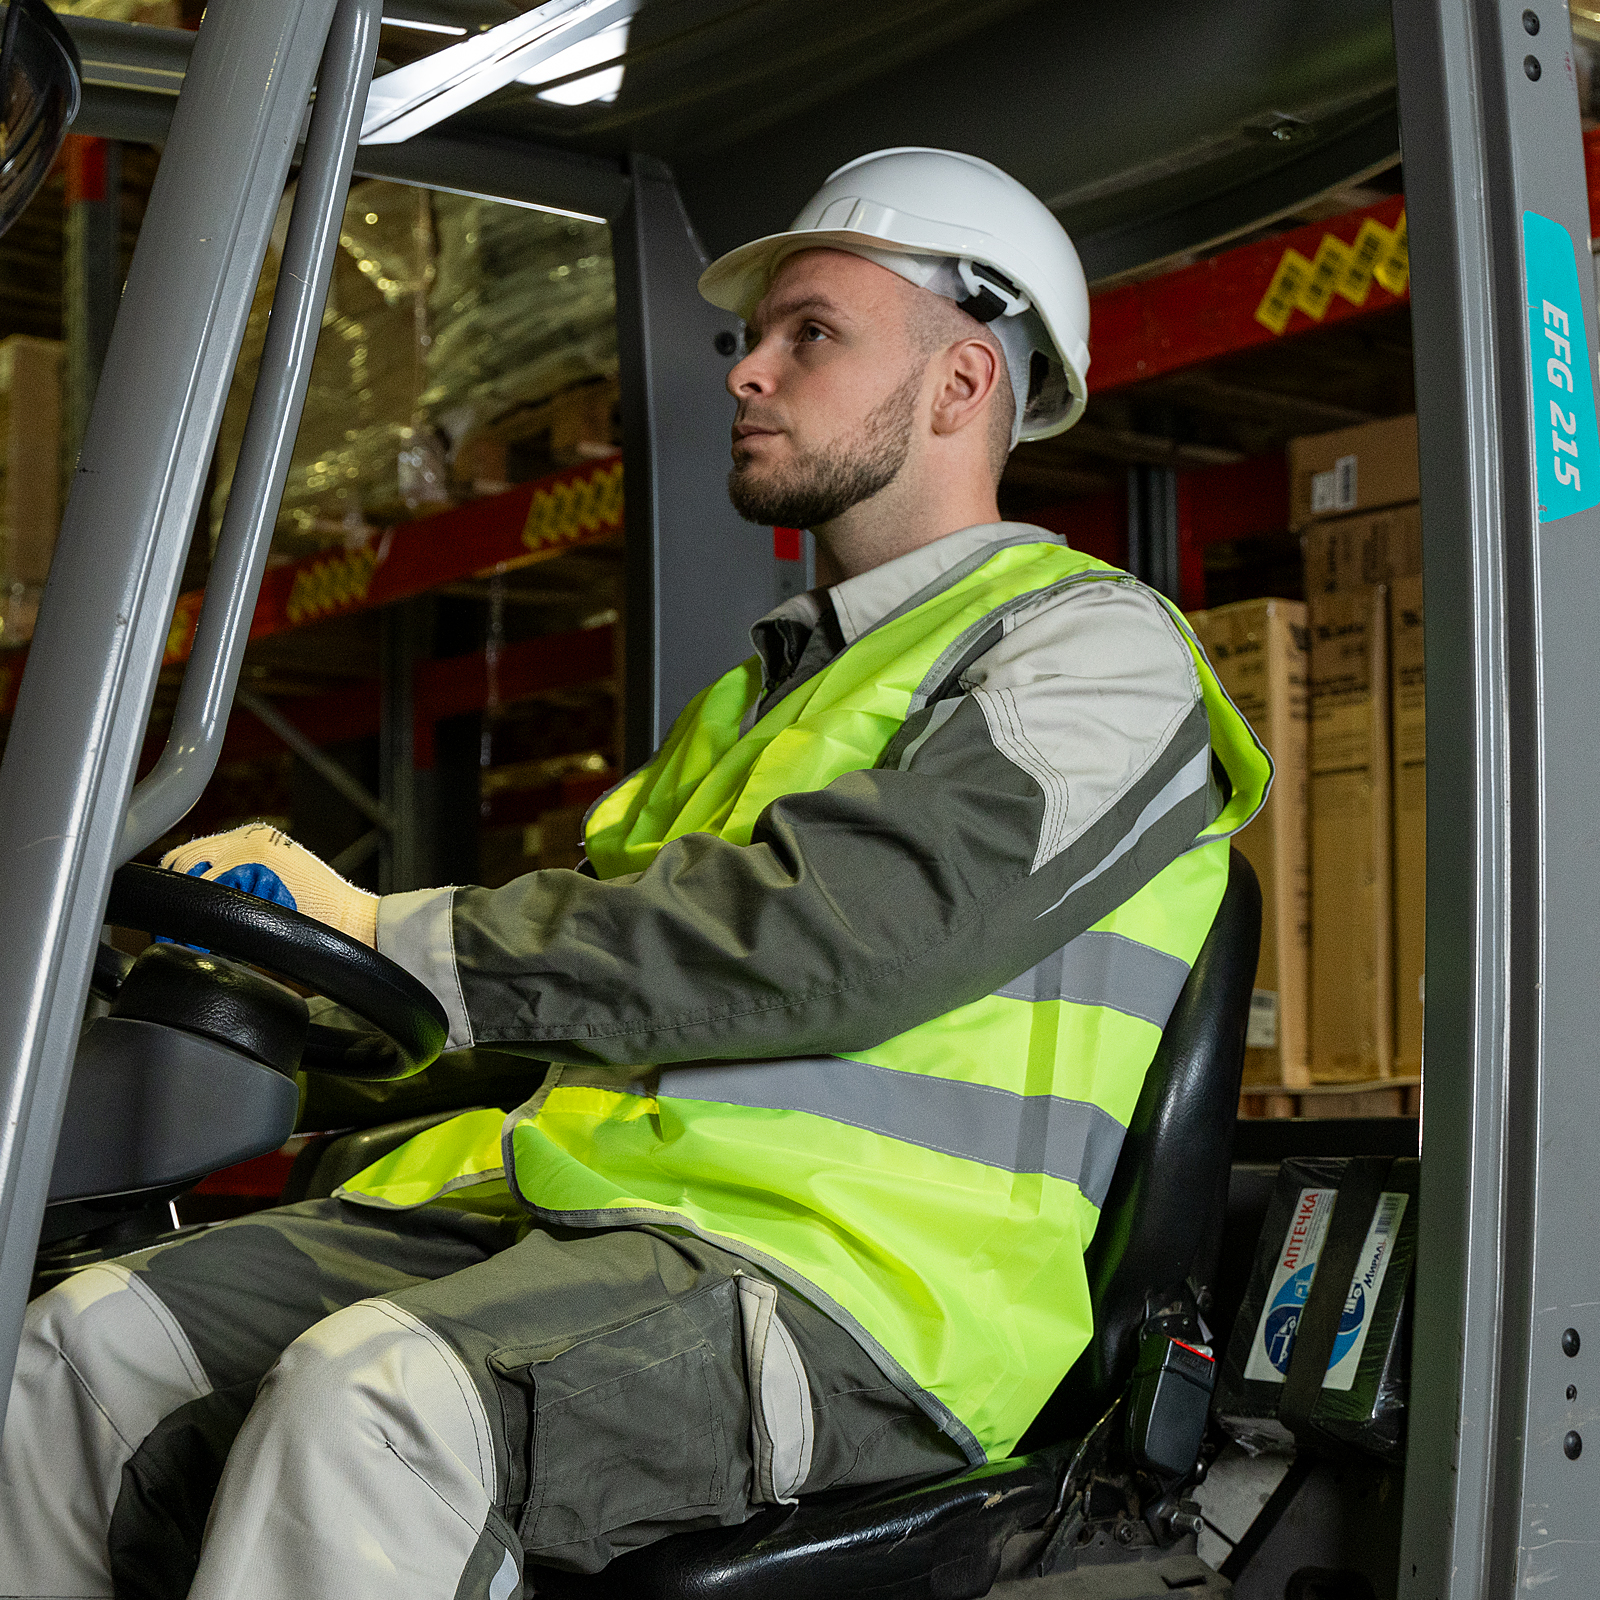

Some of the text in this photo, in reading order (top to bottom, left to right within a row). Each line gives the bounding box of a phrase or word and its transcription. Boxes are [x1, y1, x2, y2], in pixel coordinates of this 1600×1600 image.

[1542, 299, 1581, 491] EFG 215
[1283, 1193, 1319, 1269] АПТЕЧКА
